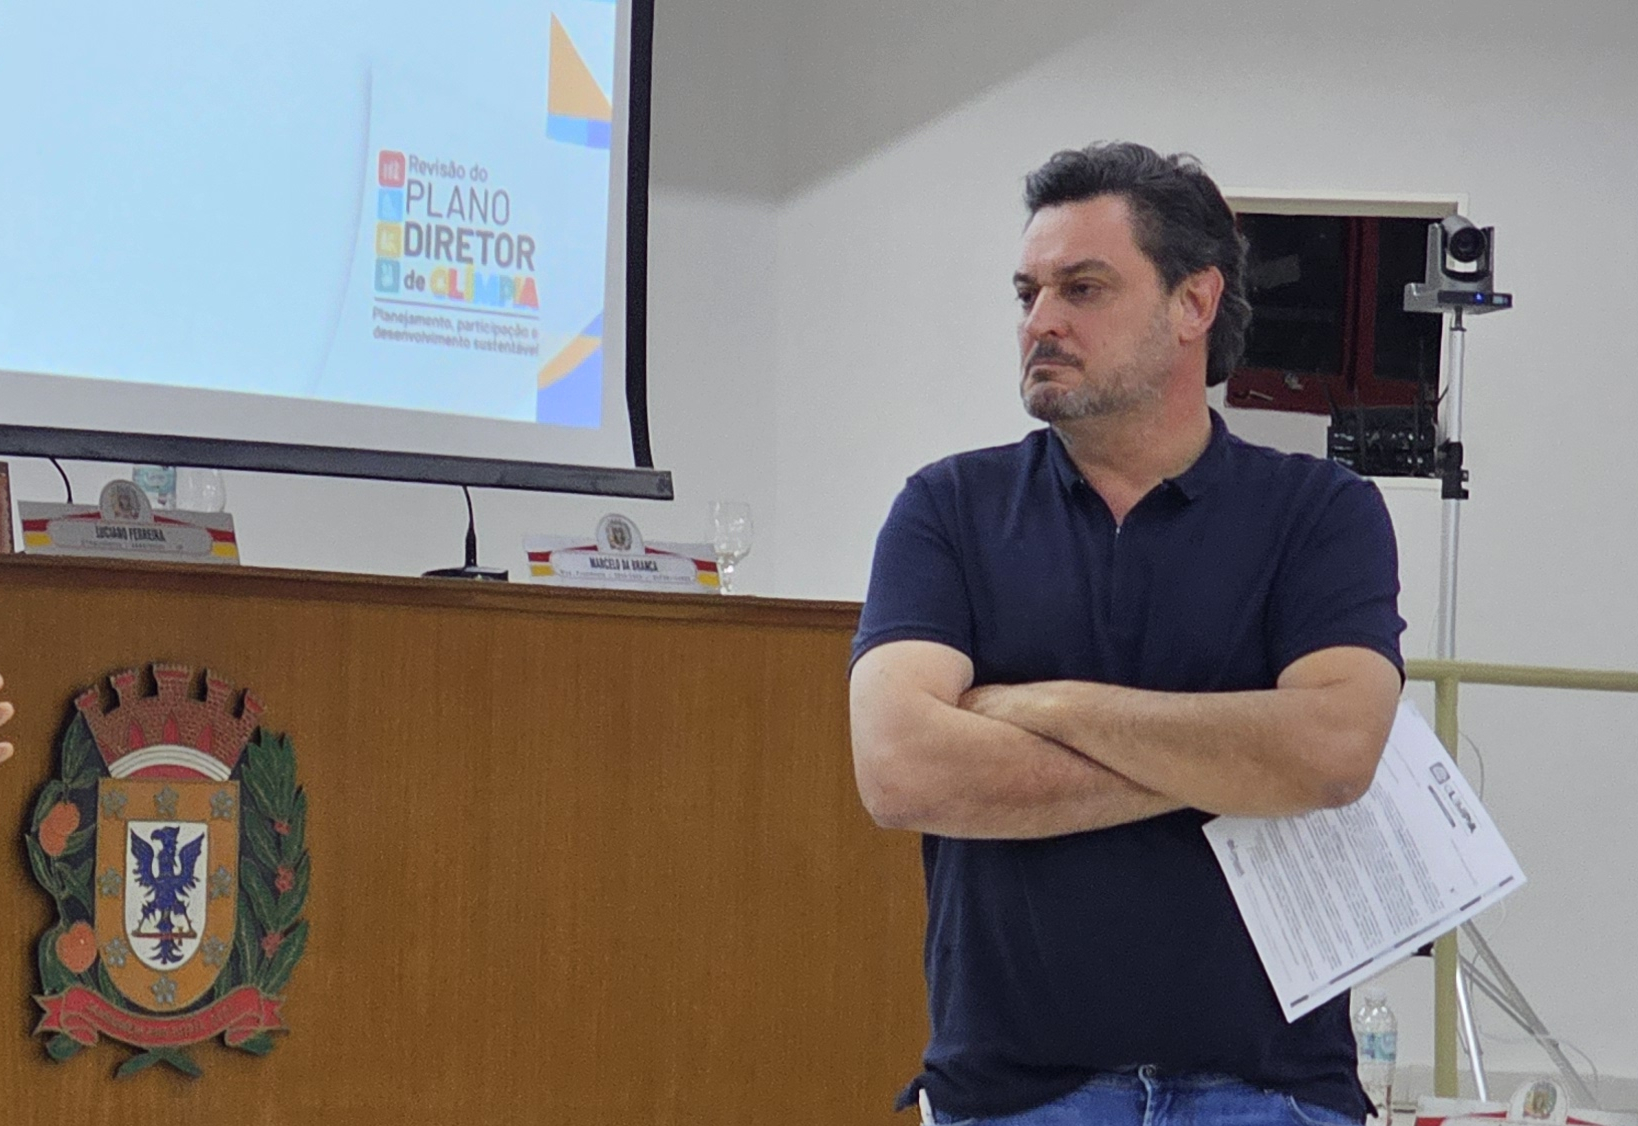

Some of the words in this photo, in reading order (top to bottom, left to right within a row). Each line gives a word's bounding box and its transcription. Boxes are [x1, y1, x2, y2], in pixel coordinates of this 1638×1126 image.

[409, 154, 466, 179] Revisão
[469, 164, 488, 182] do
[406, 178, 510, 226] PLANO
[404, 221, 536, 271] DIRETOR
[403, 269, 426, 292] de
[95, 525, 127, 541] LUCIANO
[128, 527, 166, 543] FERREIRA
[589, 557, 621, 570] MARCELO
[622, 559, 631, 571] DA
